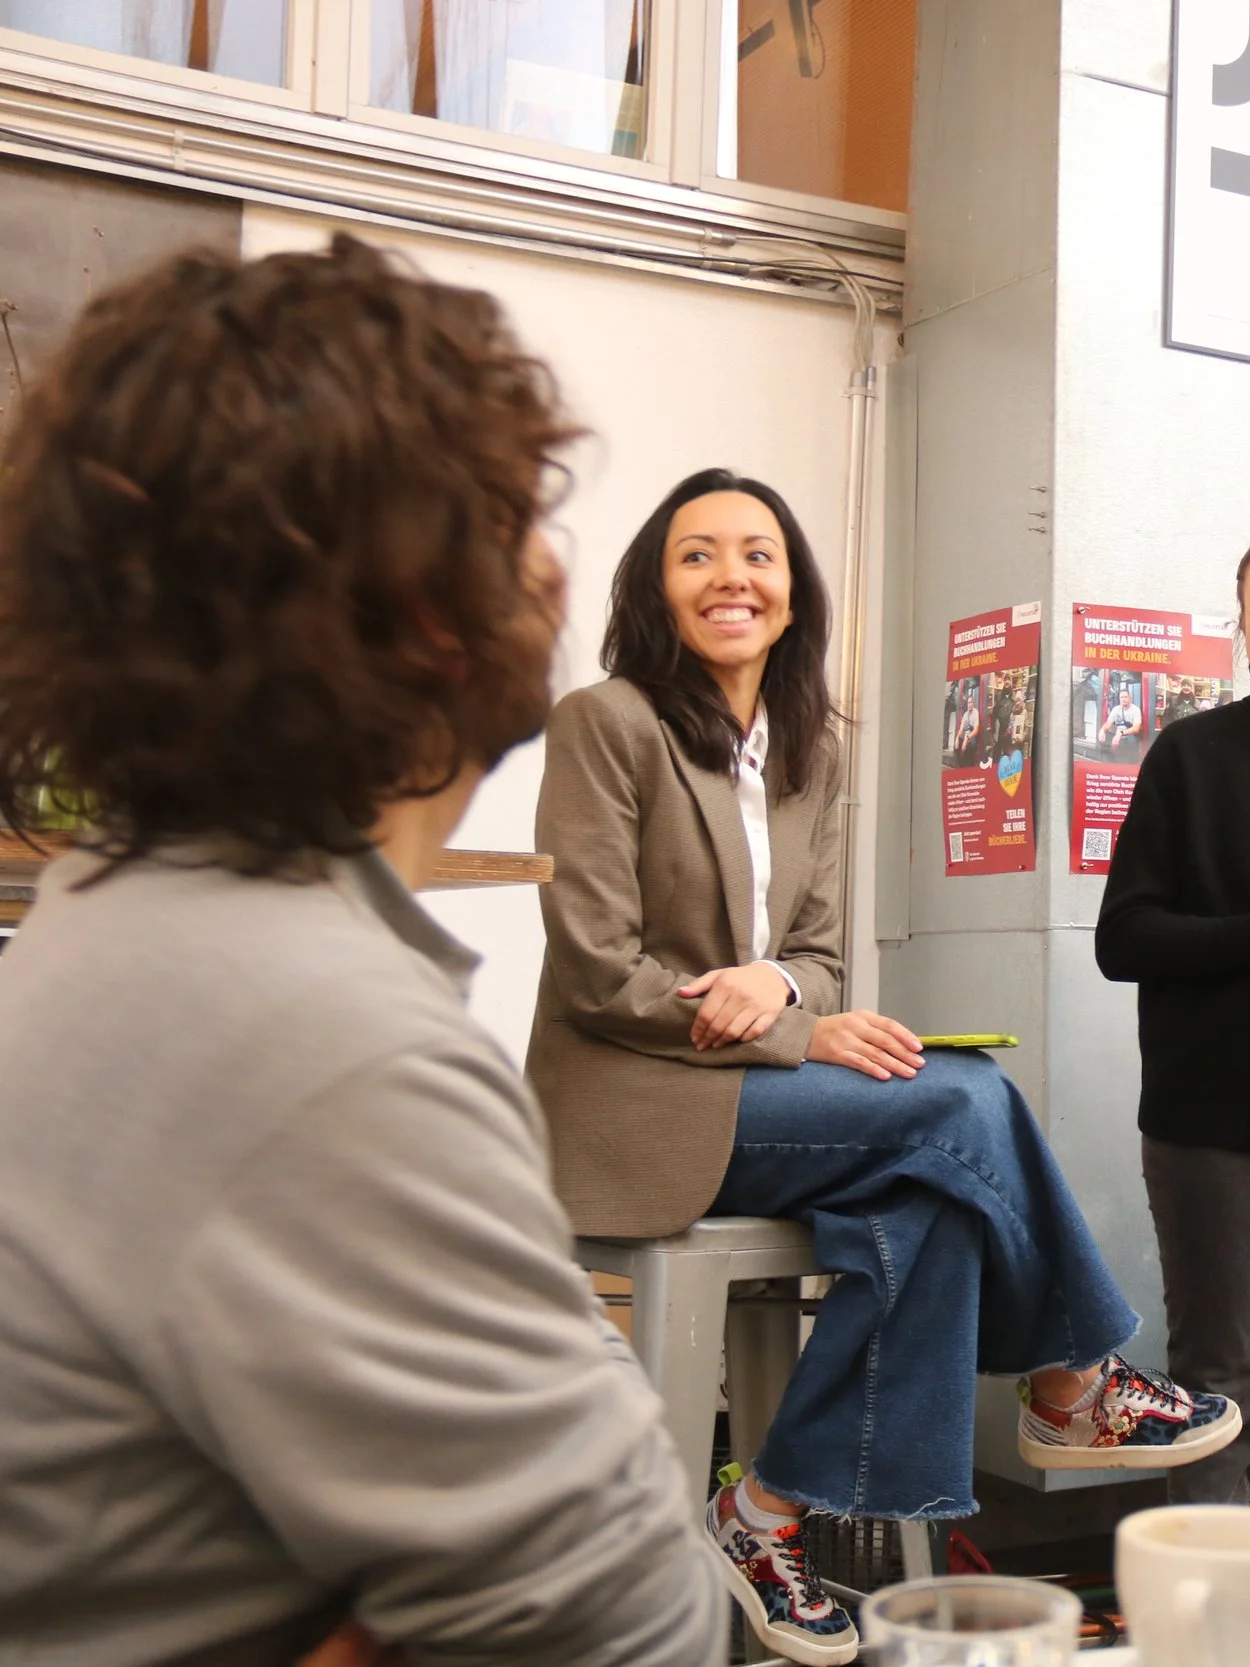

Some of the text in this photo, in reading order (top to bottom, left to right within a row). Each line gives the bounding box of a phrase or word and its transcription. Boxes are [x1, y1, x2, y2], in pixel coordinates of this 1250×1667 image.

[996, 622, 1006, 634] SIE
[1084, 618, 1183, 637] UNTERSTÜTZEN SIE
[1084, 632, 1182, 651] BUCHHANDLUNGEN
[1085, 647, 1171, 664] IN DER UKRAINE.
[1006, 808, 1026, 819] TEILEN
[1003, 823, 1012, 833] SIE
